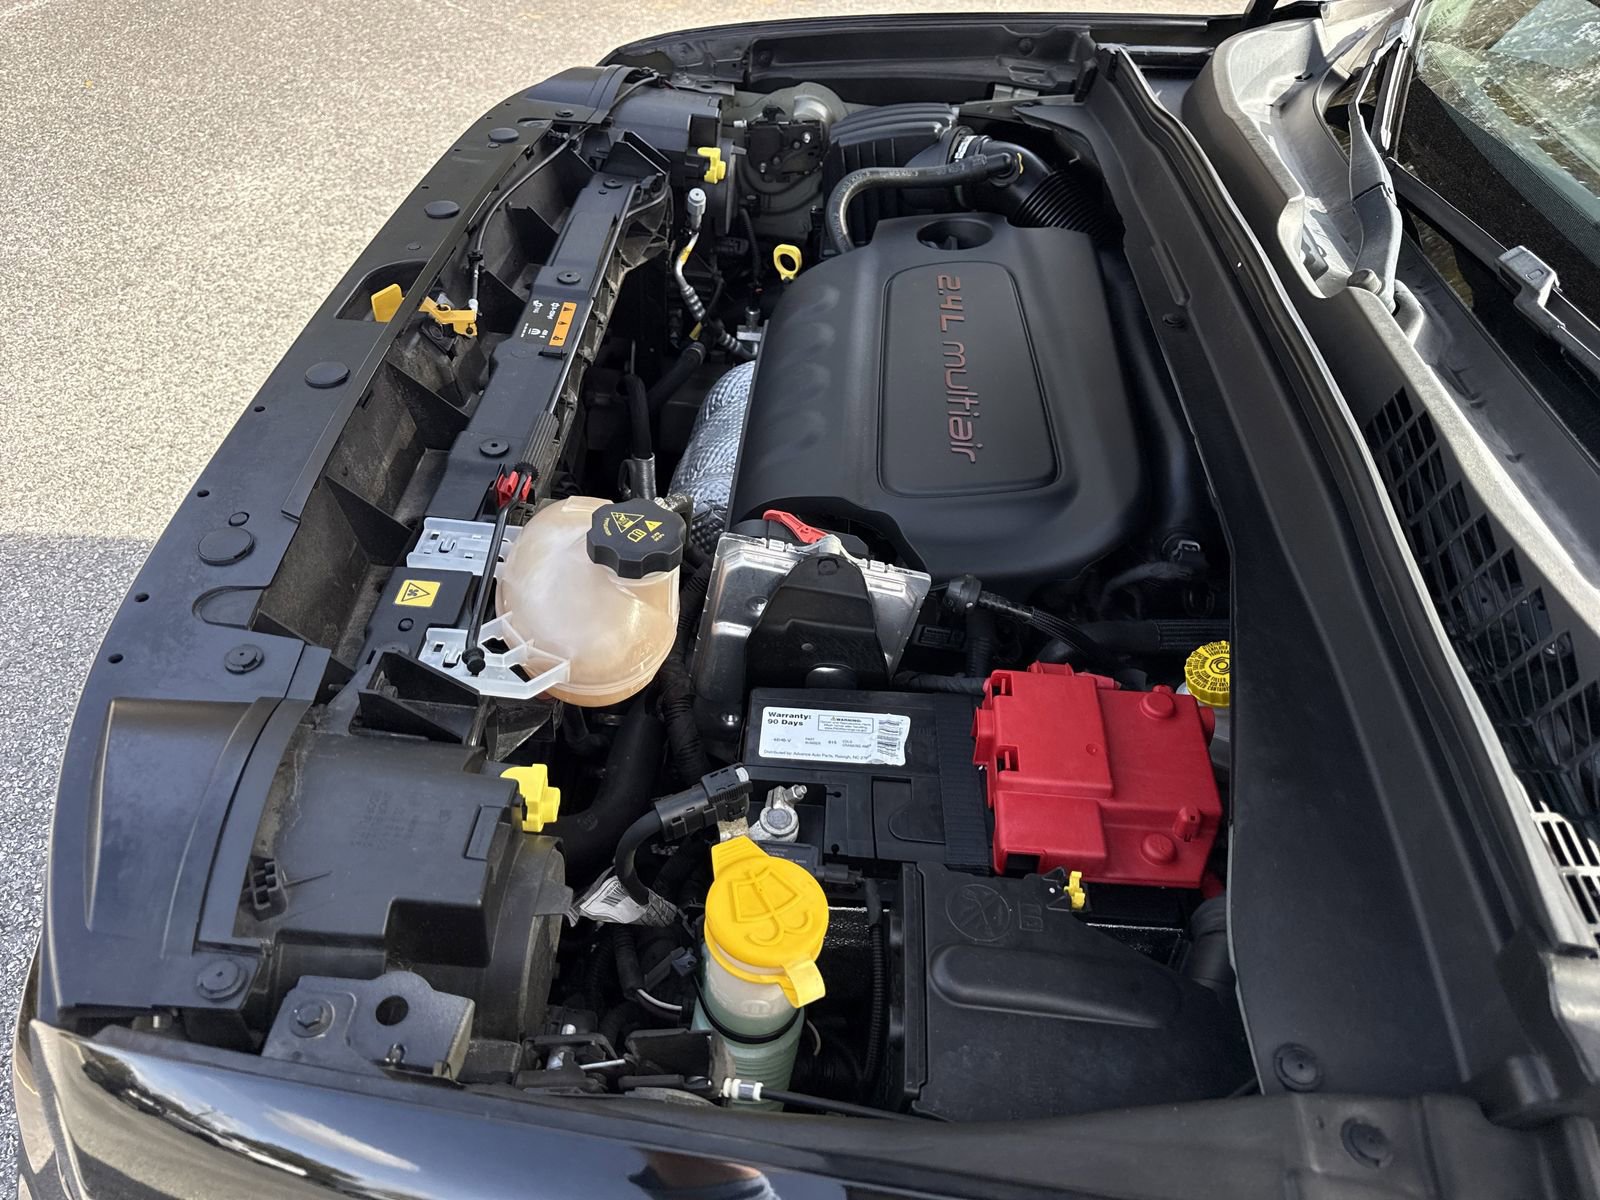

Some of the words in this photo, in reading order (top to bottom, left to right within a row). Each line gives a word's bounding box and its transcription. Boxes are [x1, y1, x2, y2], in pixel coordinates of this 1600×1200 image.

[936, 274, 965, 332] 2.4L
[942, 341, 984, 464] multiair
[768, 711, 812, 720] Warranty:
